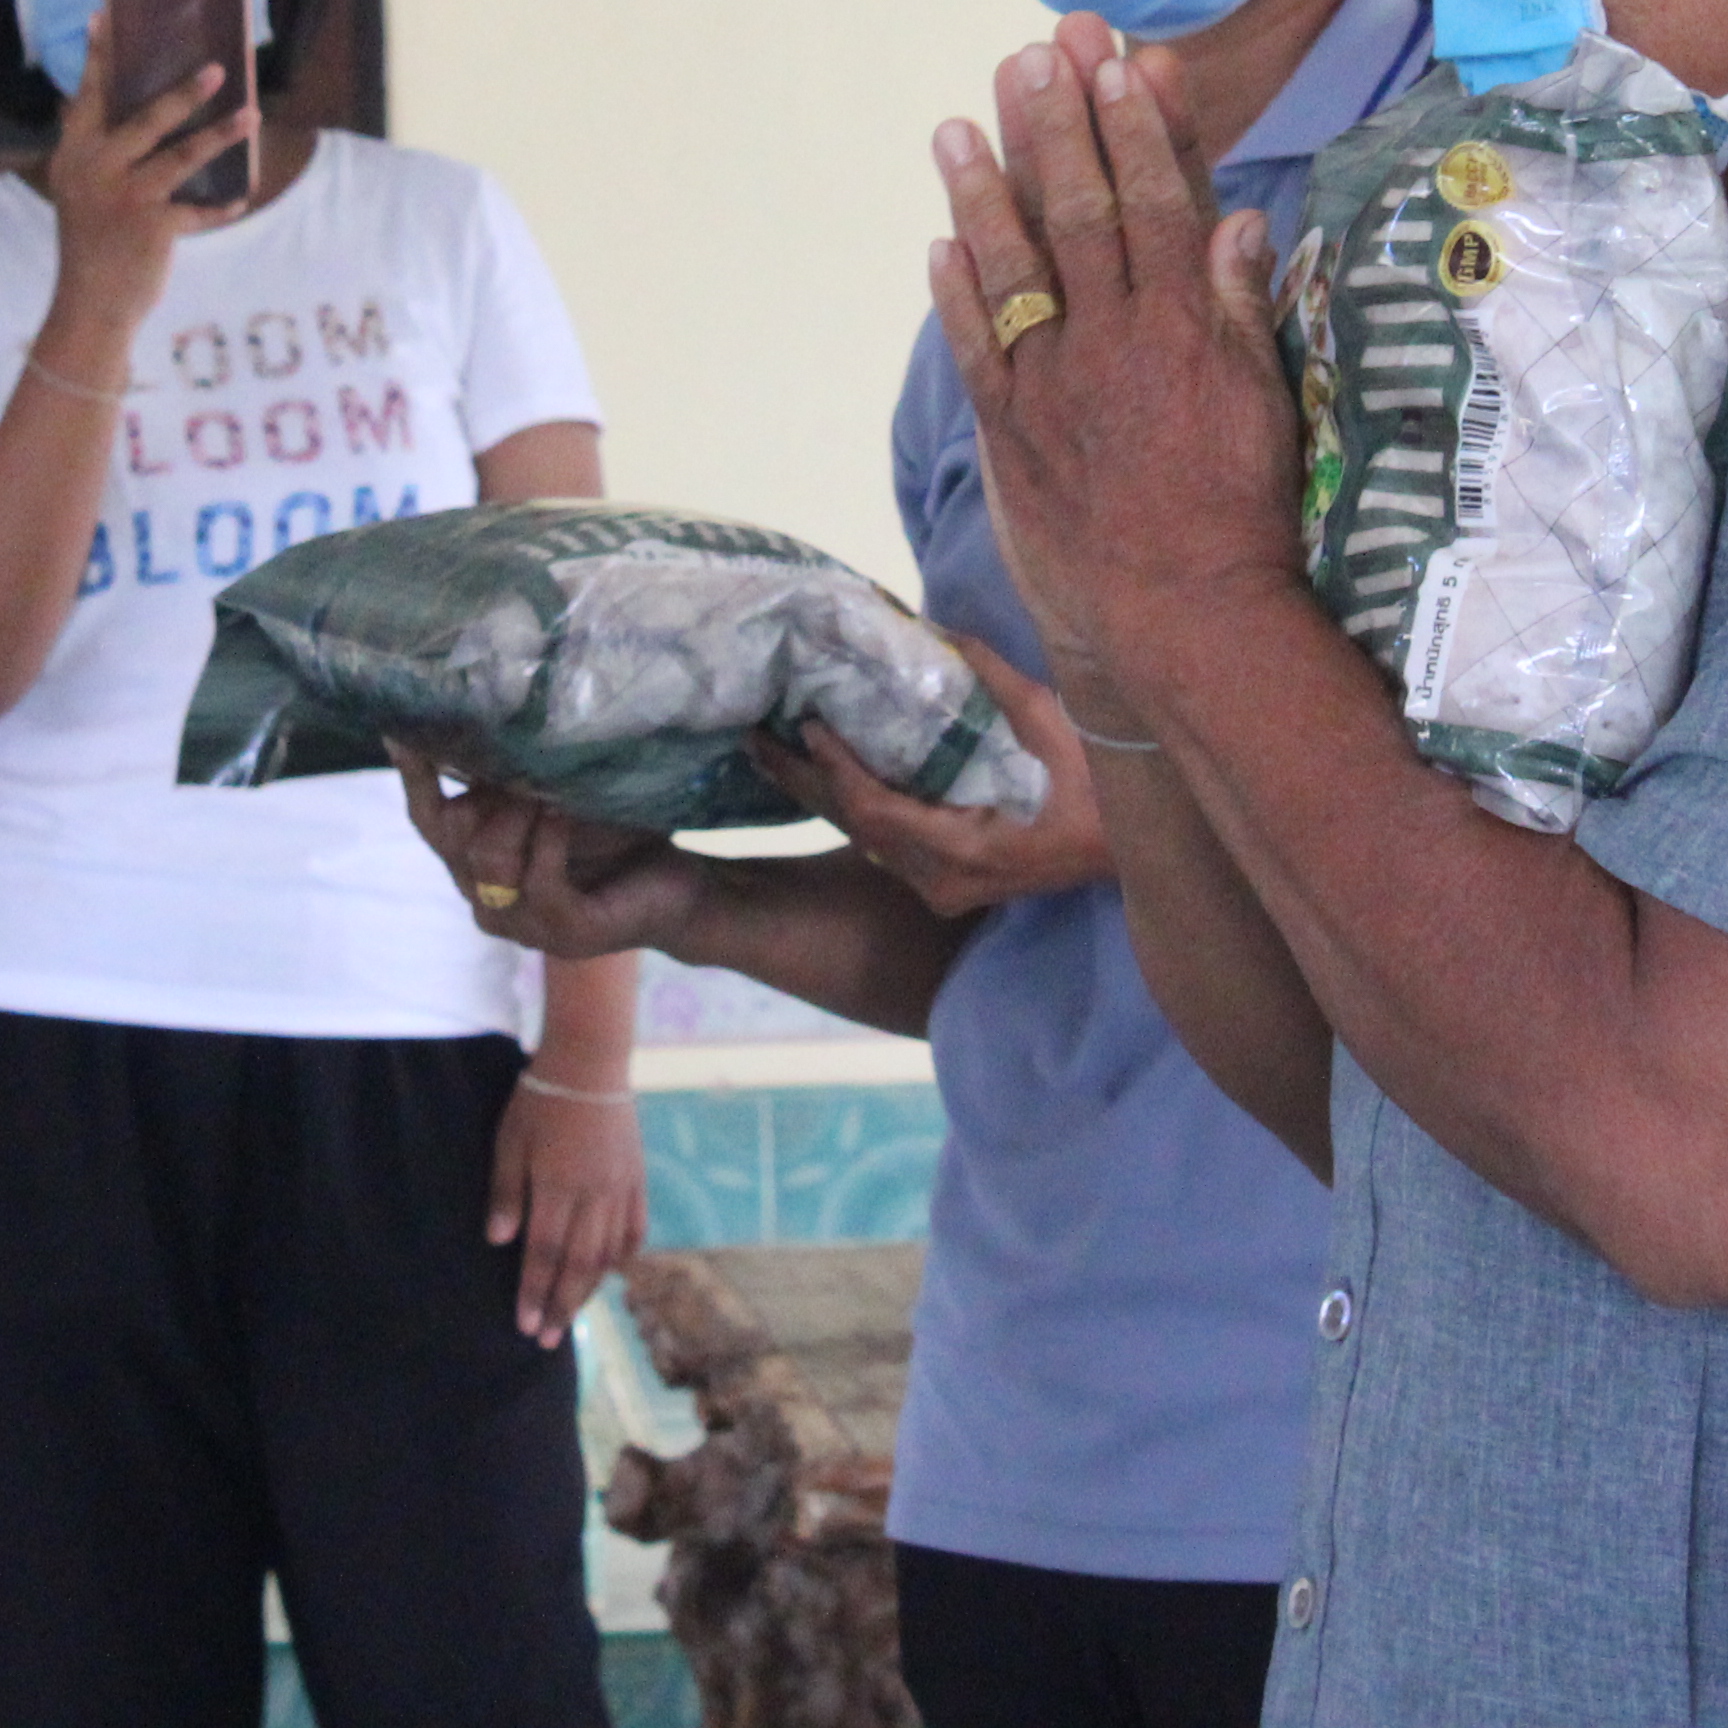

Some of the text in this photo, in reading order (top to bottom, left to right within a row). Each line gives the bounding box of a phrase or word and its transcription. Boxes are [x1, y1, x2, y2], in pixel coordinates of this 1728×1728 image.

[1456, 232, 1480, 283] GMP
[125, 377, 417, 477] LOOM
[1444, 574, 1459, 589] 5
